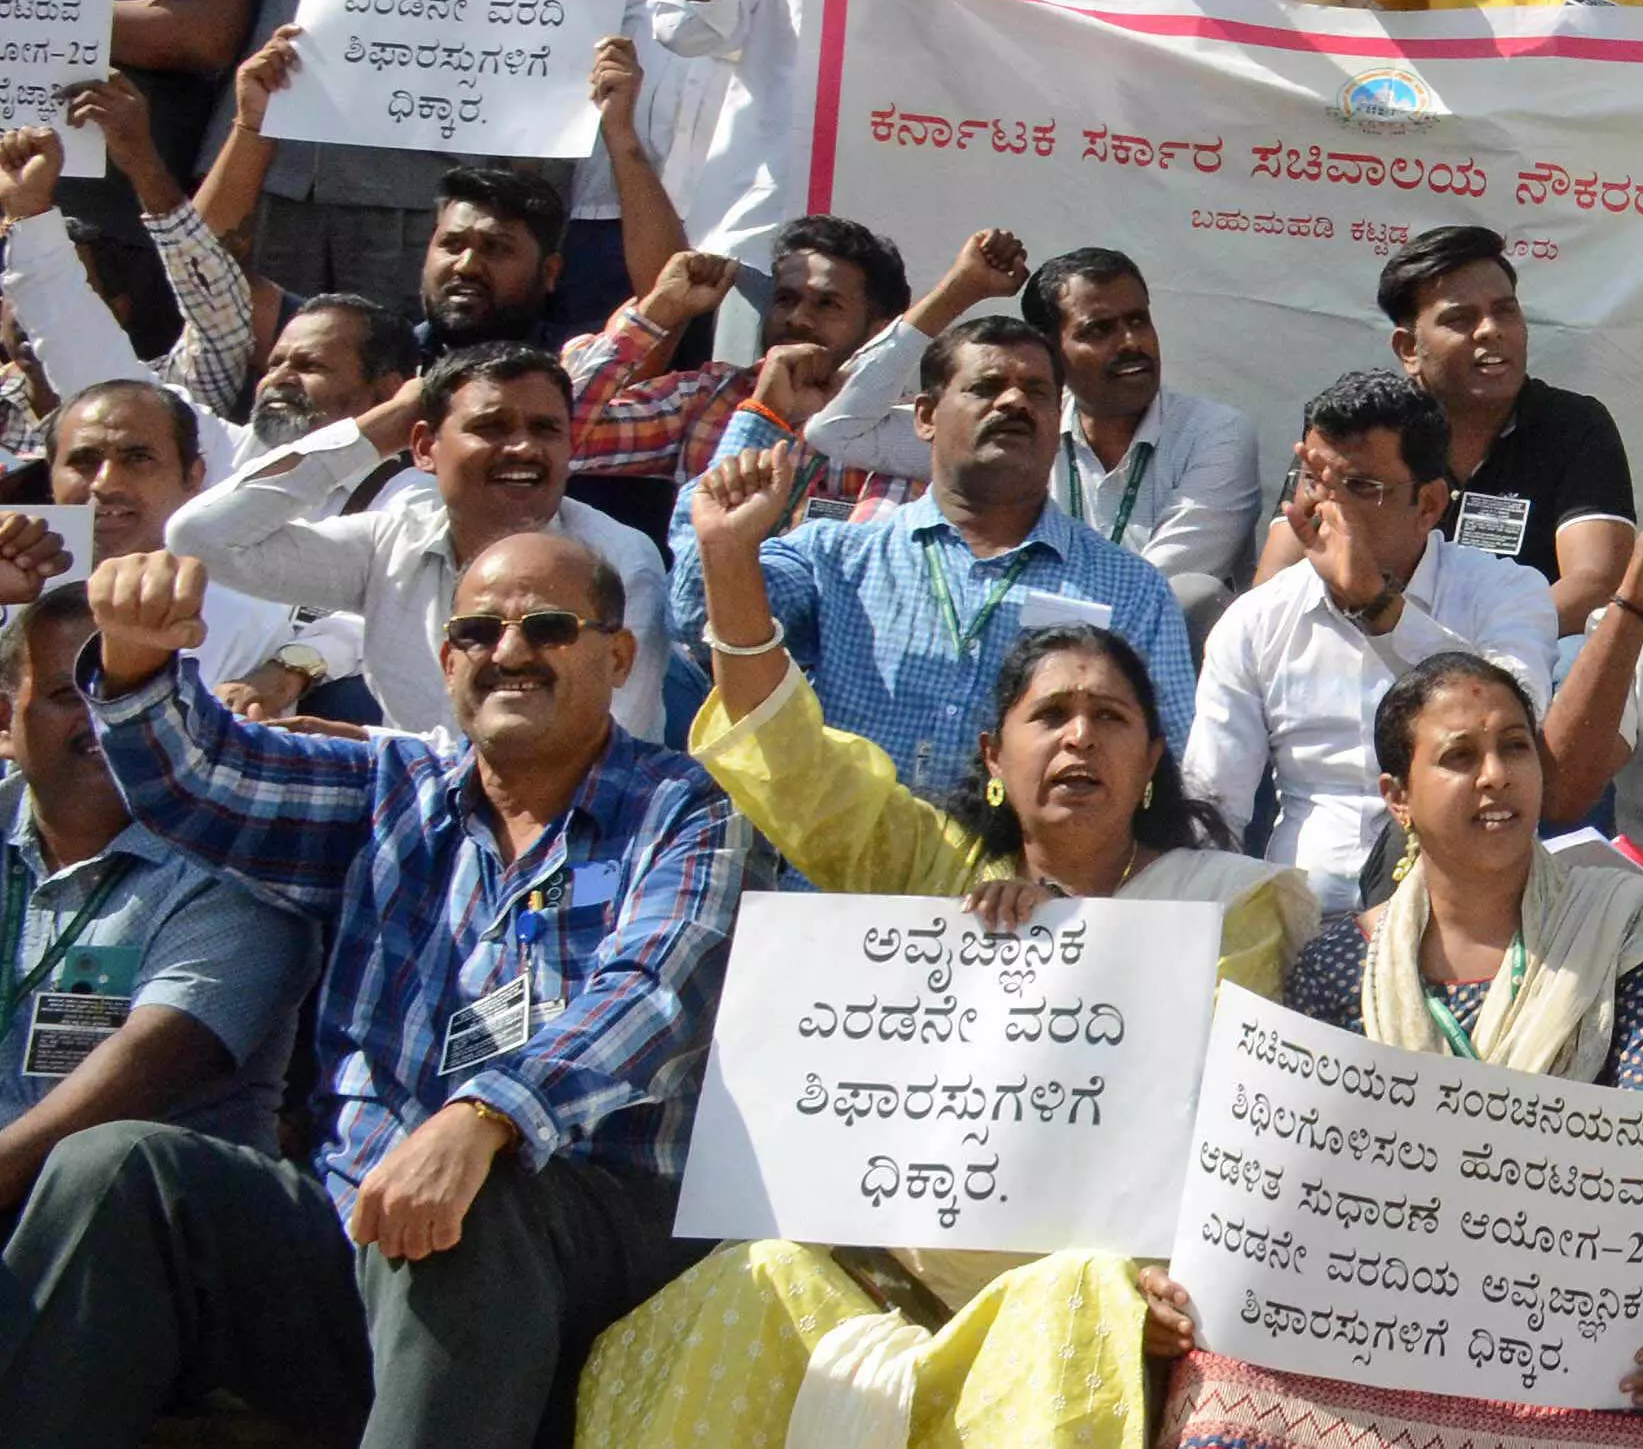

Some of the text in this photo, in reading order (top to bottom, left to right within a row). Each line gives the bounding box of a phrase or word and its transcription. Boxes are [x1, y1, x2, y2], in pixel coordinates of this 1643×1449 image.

[344, 35, 551, 89] ಶಿಫಾರಸ್ಸುಗಳಿಗೆ
[388, 90, 487, 139] ಧಿಕ್ಕಾರ.
[871, 102, 1057, 158] ಕರ್ನಾಟಕ
[1082, 123, 1223, 173] ಸರ್ಕಾರ
[1251, 138, 1488, 198] ಸಚಿವಾಲಯ
[1191, 207, 1411, 255] ಬಹುಮಹಡಿ ಕಟ್ಟಡ
[862, 917, 1088, 998] ಅವೈಜ್ಞಾನಿಕ
[798, 994, 1127, 1046] ಎರಡನೇ ವರದಿ
[1236, 1019, 1420, 1108] ಸಚಿವಾಲಯದ
[796, 1071, 1106, 1146] ಶಿಫಾರಸ್ಸುಗಳಿಗೆ
[1231, 1083, 1439, 1173] ಶಿಥಿಲಗೊಳಿಸಲು
[860, 1152, 1009, 1229] ಧಿಕ್ಕಾರ.
[1200, 1140, 1284, 1201] ಆಡಳಿತ
[1298, 1178, 1441, 1234] ಸುಧಾರಣೆ
[1202, 1212, 1643, 1342] ಎರಡನೇ ವರದಿಯ ಅವೈಜ್ಞಾನಿಕ
[1240, 1289, 1569, 1389] ಶಿಫಾರಸ್ಸುಗಳಿಗೆ ಧಿಕ್ಕಾರ.
